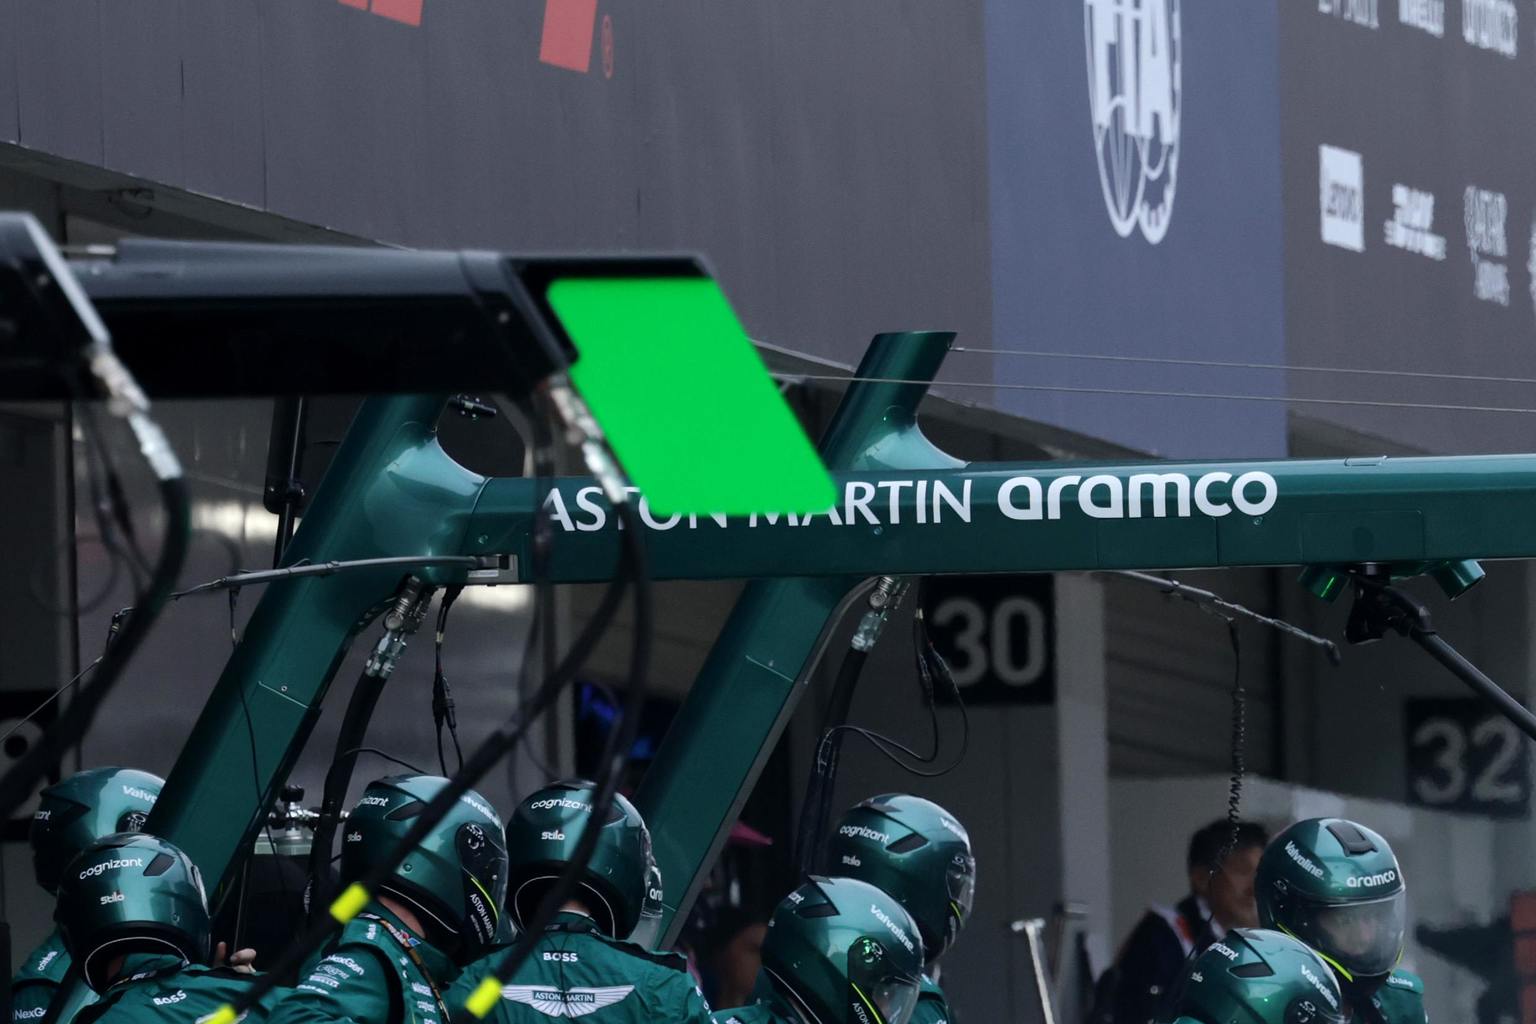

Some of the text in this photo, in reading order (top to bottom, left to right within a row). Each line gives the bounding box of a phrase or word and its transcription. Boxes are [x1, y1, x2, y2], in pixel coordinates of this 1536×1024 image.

[998, 471, 1279, 521] aramco
[932, 597, 1046, 688] 30
[1413, 719, 1523, 803] 32
[839, 824, 890, 843] cognizant
[79, 857, 143, 880] cognizant
[1284, 840, 1325, 880] Valvoline
[1346, 869, 1396, 888] aramco
[870, 904, 915, 954] Valvoline
[543, 953, 578, 963] BOSS
[534, 991, 561, 1001] ASTON
